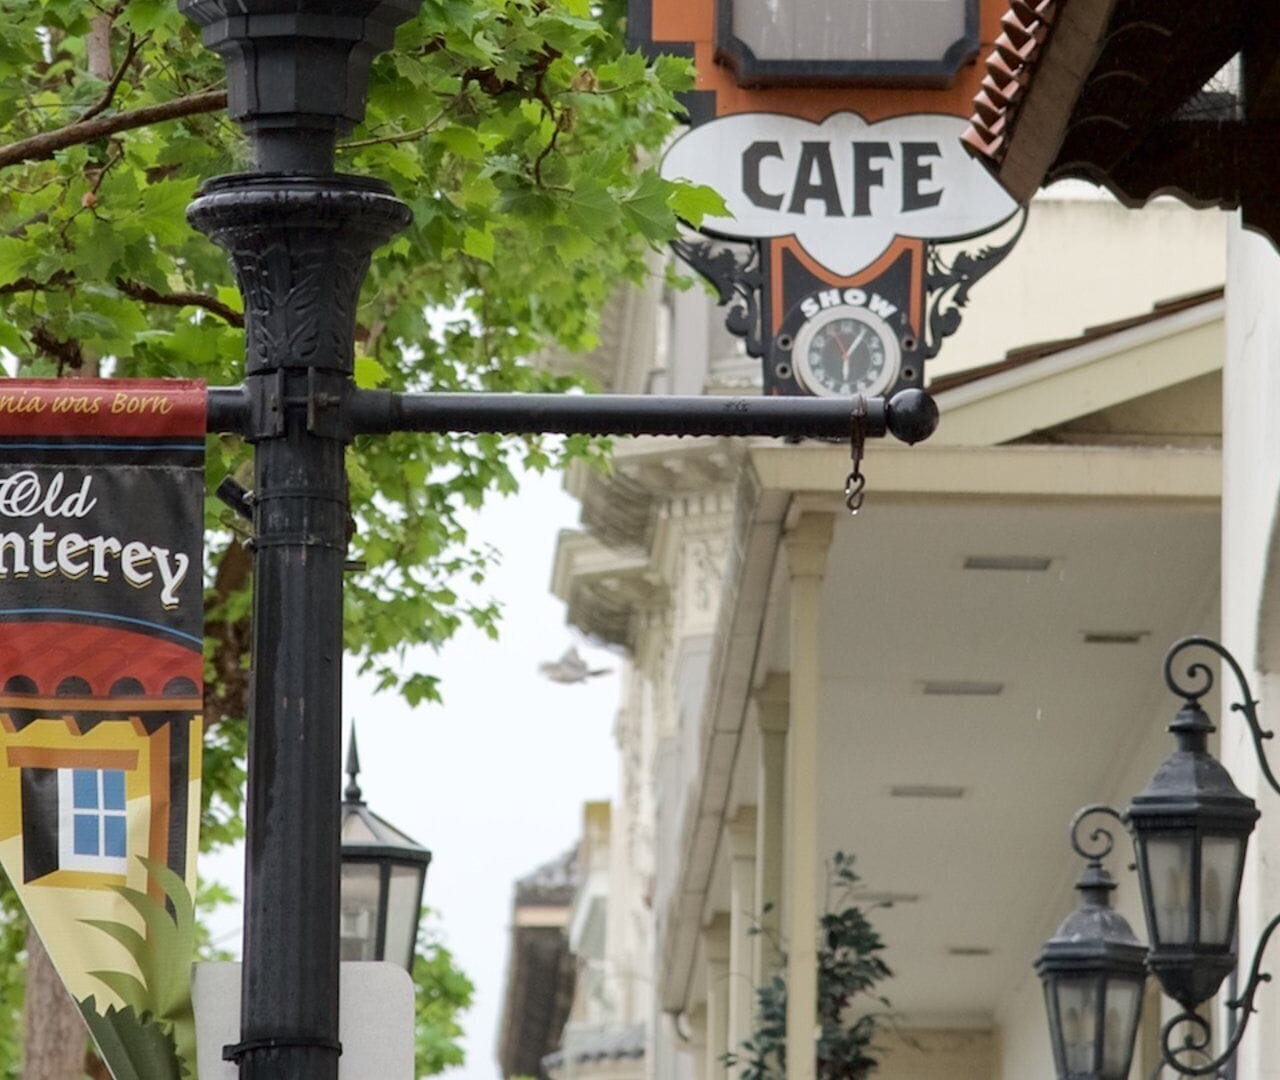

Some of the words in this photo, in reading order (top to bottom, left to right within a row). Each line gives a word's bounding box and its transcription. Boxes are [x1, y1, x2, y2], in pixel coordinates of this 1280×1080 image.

[741, 140, 945, 218] CAFE
[800, 287, 899, 319] SHOW
[51, 393, 102, 414] was
[110, 392, 173, 415] Born
